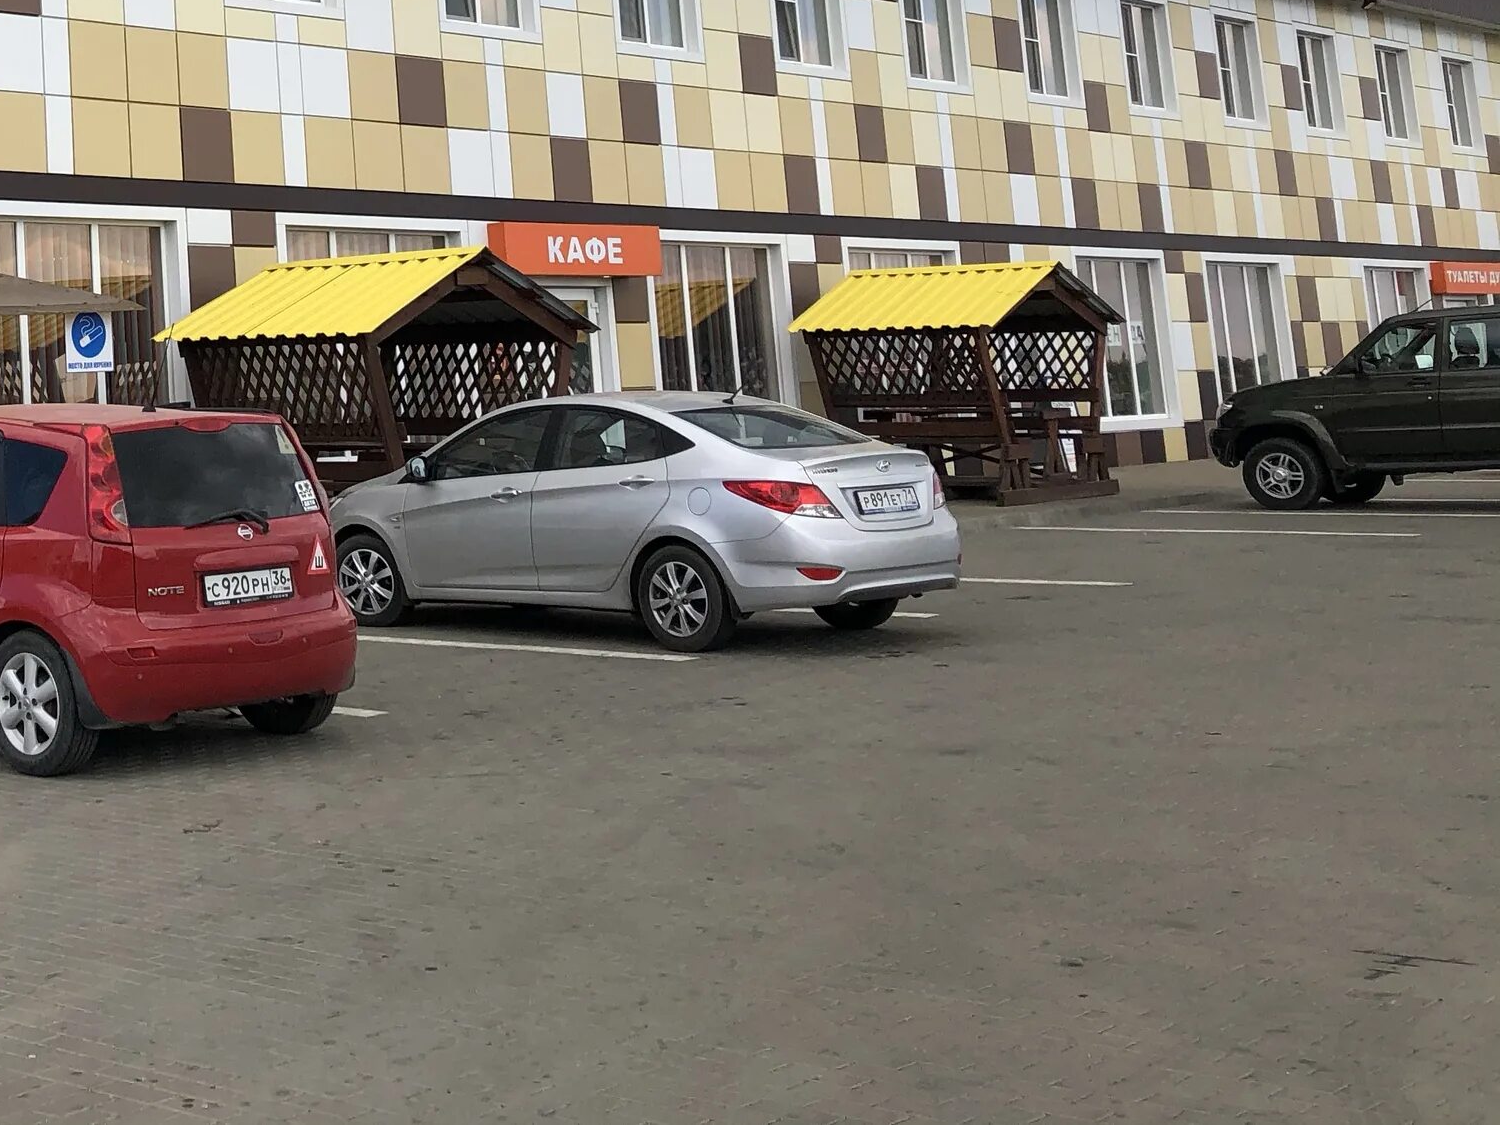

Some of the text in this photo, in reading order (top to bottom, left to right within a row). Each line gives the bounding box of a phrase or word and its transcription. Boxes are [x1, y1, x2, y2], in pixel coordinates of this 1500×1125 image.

[547, 236, 624, 264] КАФЕ
[1446, 269, 1488, 284] ТУАЛЕТЫ
[315, 556, 324, 568] Ш
[272, 570, 287, 586] 36
[147, 586, 185, 596] NOTE
